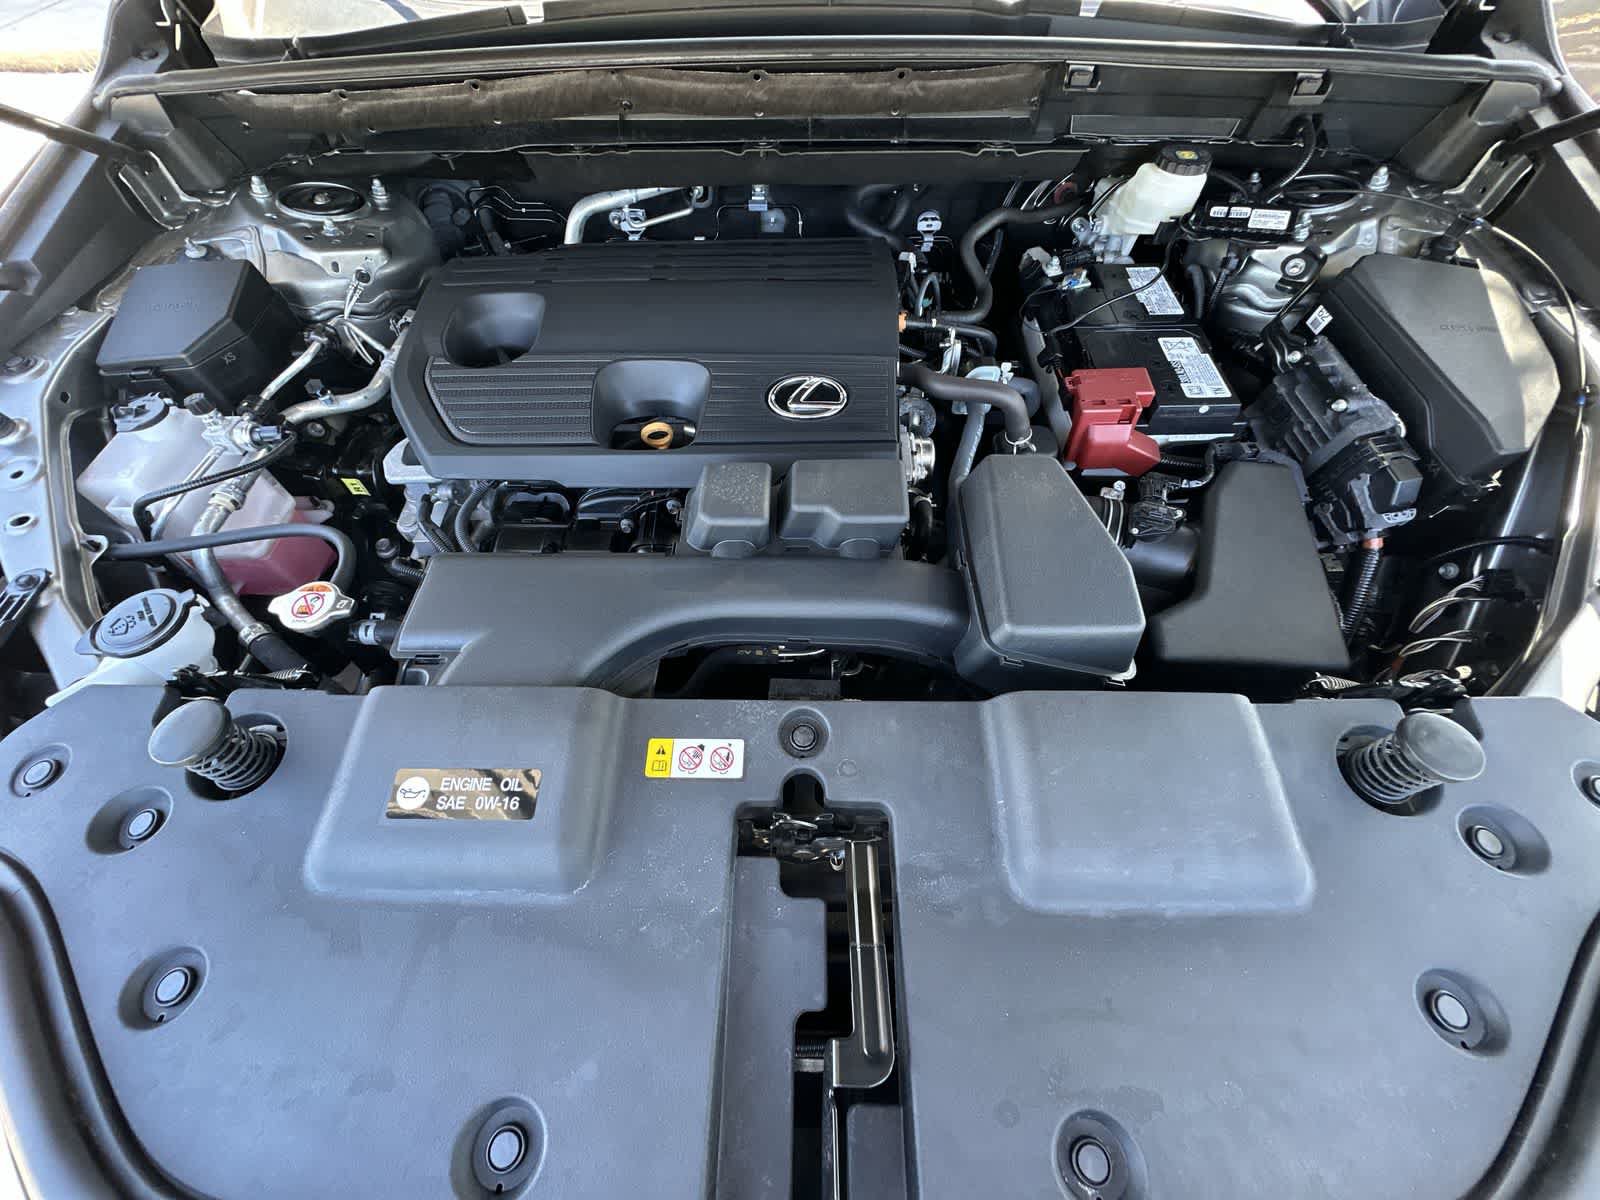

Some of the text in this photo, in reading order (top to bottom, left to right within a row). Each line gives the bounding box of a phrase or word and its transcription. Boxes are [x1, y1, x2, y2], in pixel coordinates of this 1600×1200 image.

[440, 777, 523, 791] ENGINE OIL
[436, 796, 520, 810] SAE 0W-16
